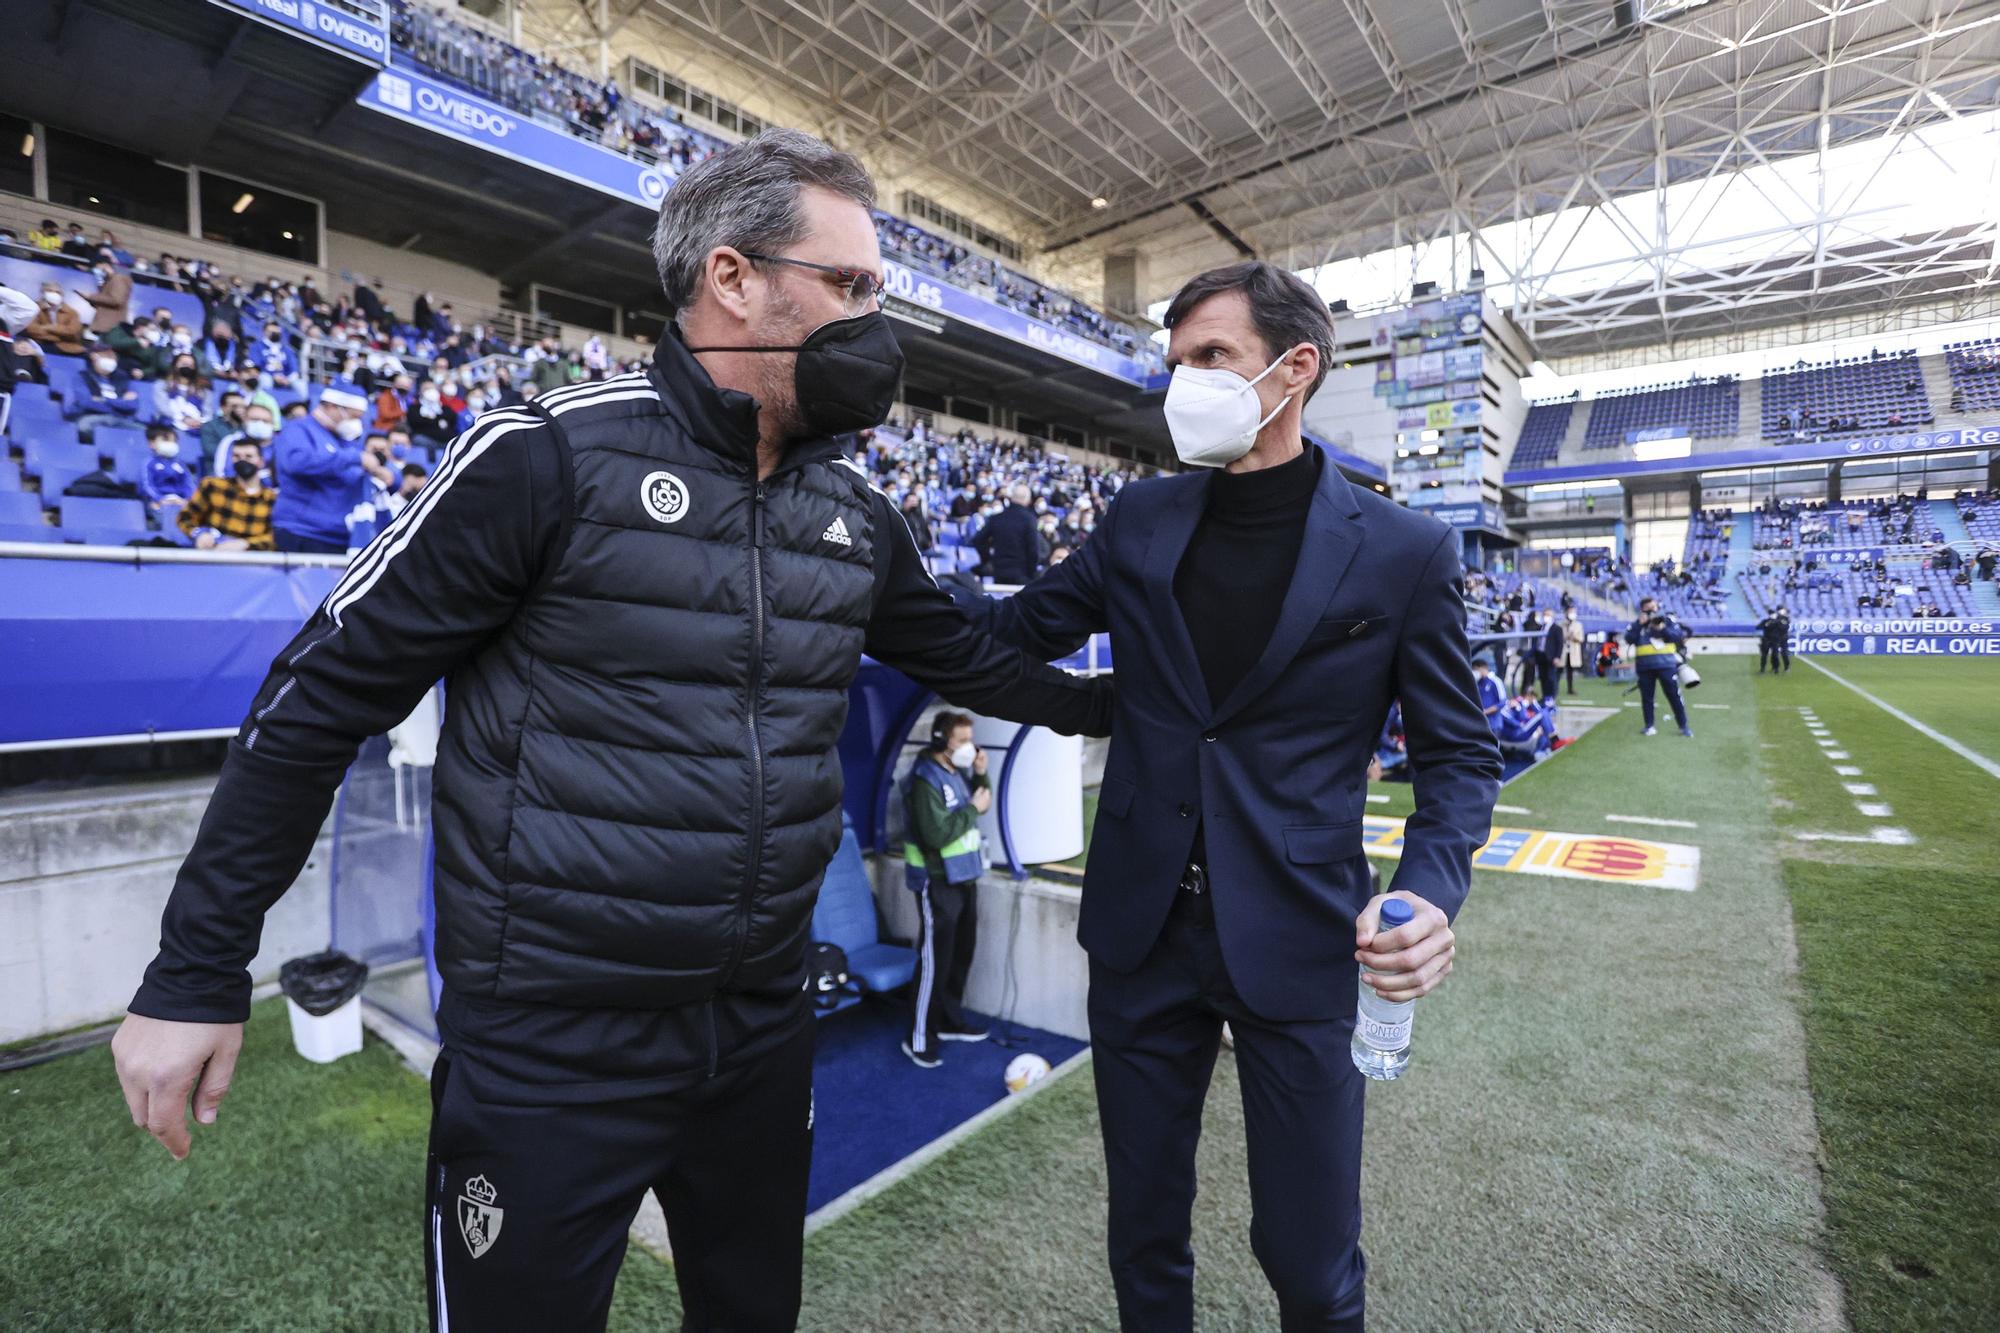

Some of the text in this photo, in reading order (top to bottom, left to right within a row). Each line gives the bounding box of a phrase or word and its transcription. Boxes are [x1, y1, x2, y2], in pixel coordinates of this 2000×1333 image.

[318, 12, 384, 54] OVIEDO
[415, 87, 510, 138] OVIEDO
[822, 531, 852, 547] adidas
[1850, 619, 1993, 634] RealOVIEDO.es
[1886, 638, 1944, 654] REAL
